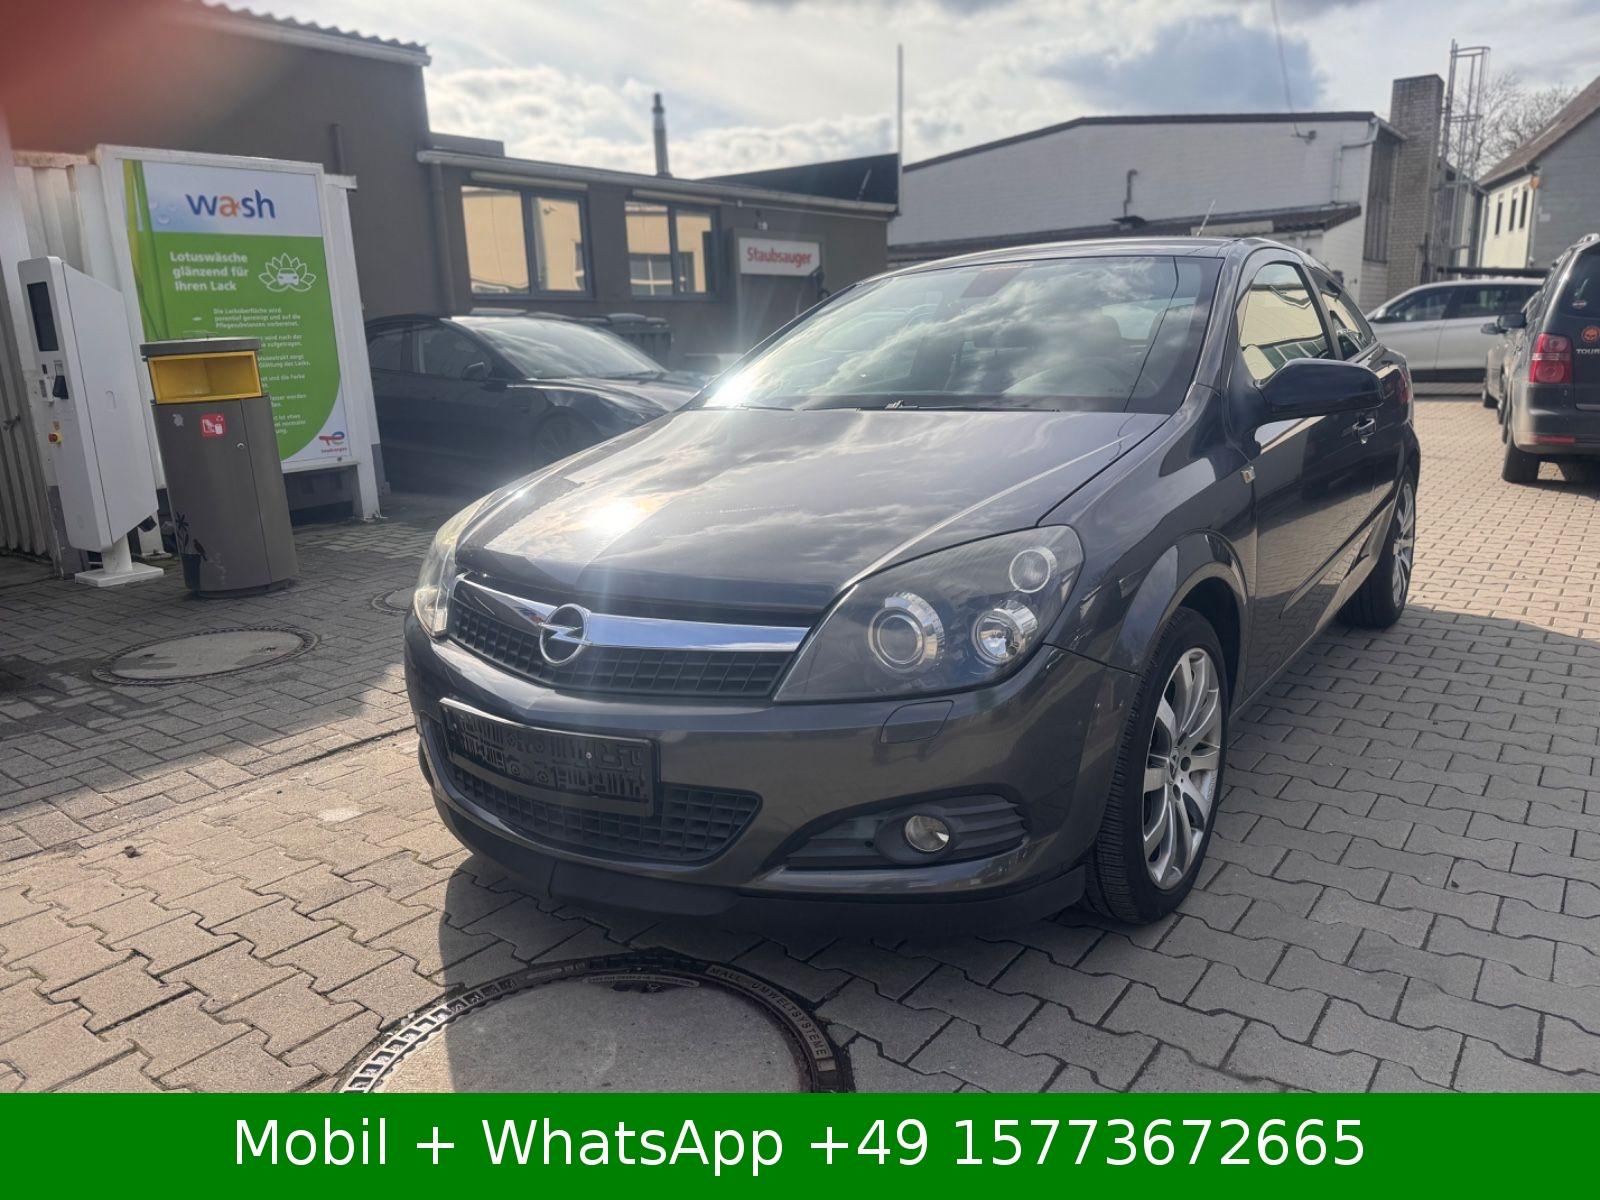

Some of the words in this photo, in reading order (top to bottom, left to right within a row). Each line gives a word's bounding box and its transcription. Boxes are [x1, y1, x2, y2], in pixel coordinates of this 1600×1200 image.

[185, 189, 276, 219] wash
[169, 251, 248, 263] Lotuswäsche
[747, 247, 812, 268] Staubsauger
[172, 265, 229, 279] glänzend
[231, 266, 249, 277] für
[175, 281, 208, 291] Ihren
[210, 281, 237, 291] Lack
